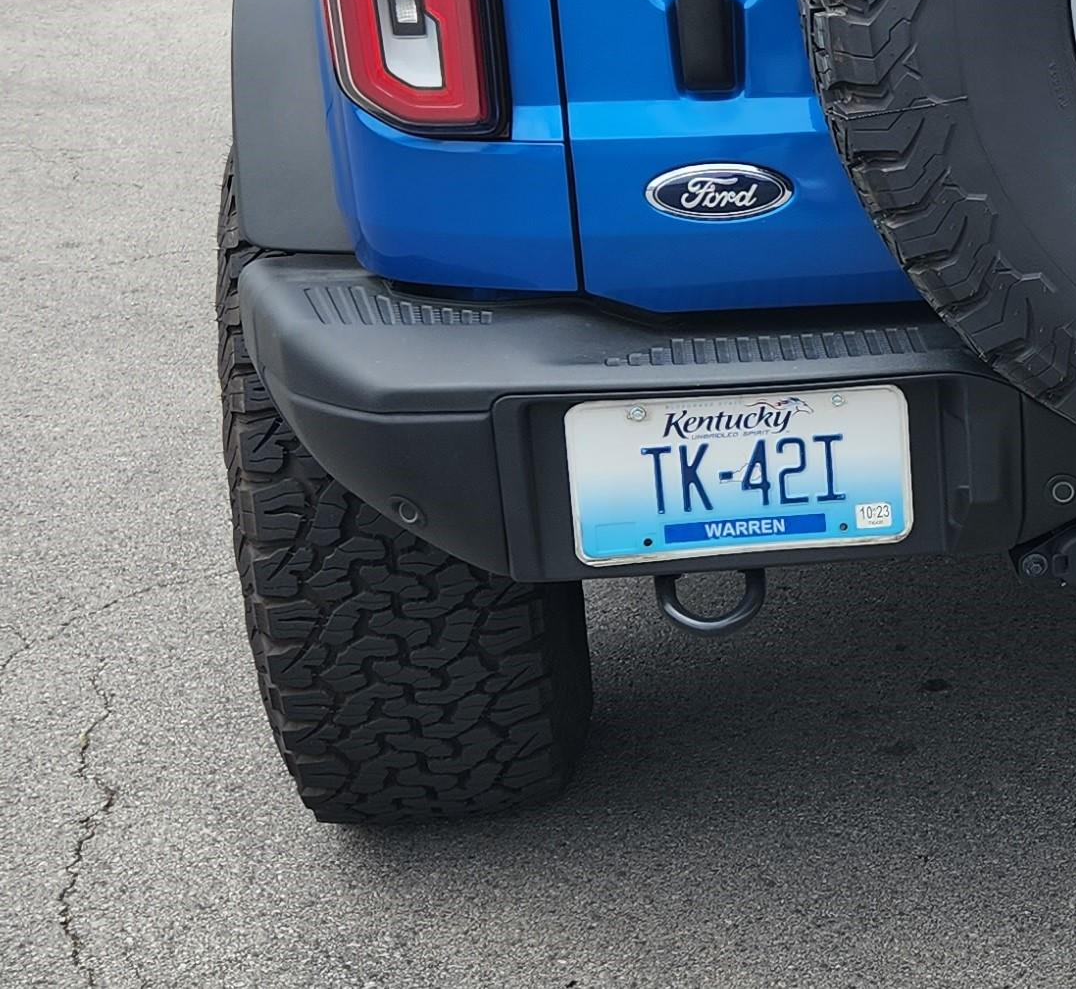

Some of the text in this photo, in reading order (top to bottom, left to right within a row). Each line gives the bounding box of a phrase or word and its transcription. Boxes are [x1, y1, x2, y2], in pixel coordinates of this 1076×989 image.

[681, 177, 758, 209] Ford
[662, 406, 792, 440] Kentucky
[705, 518, 786, 539] WARREN
